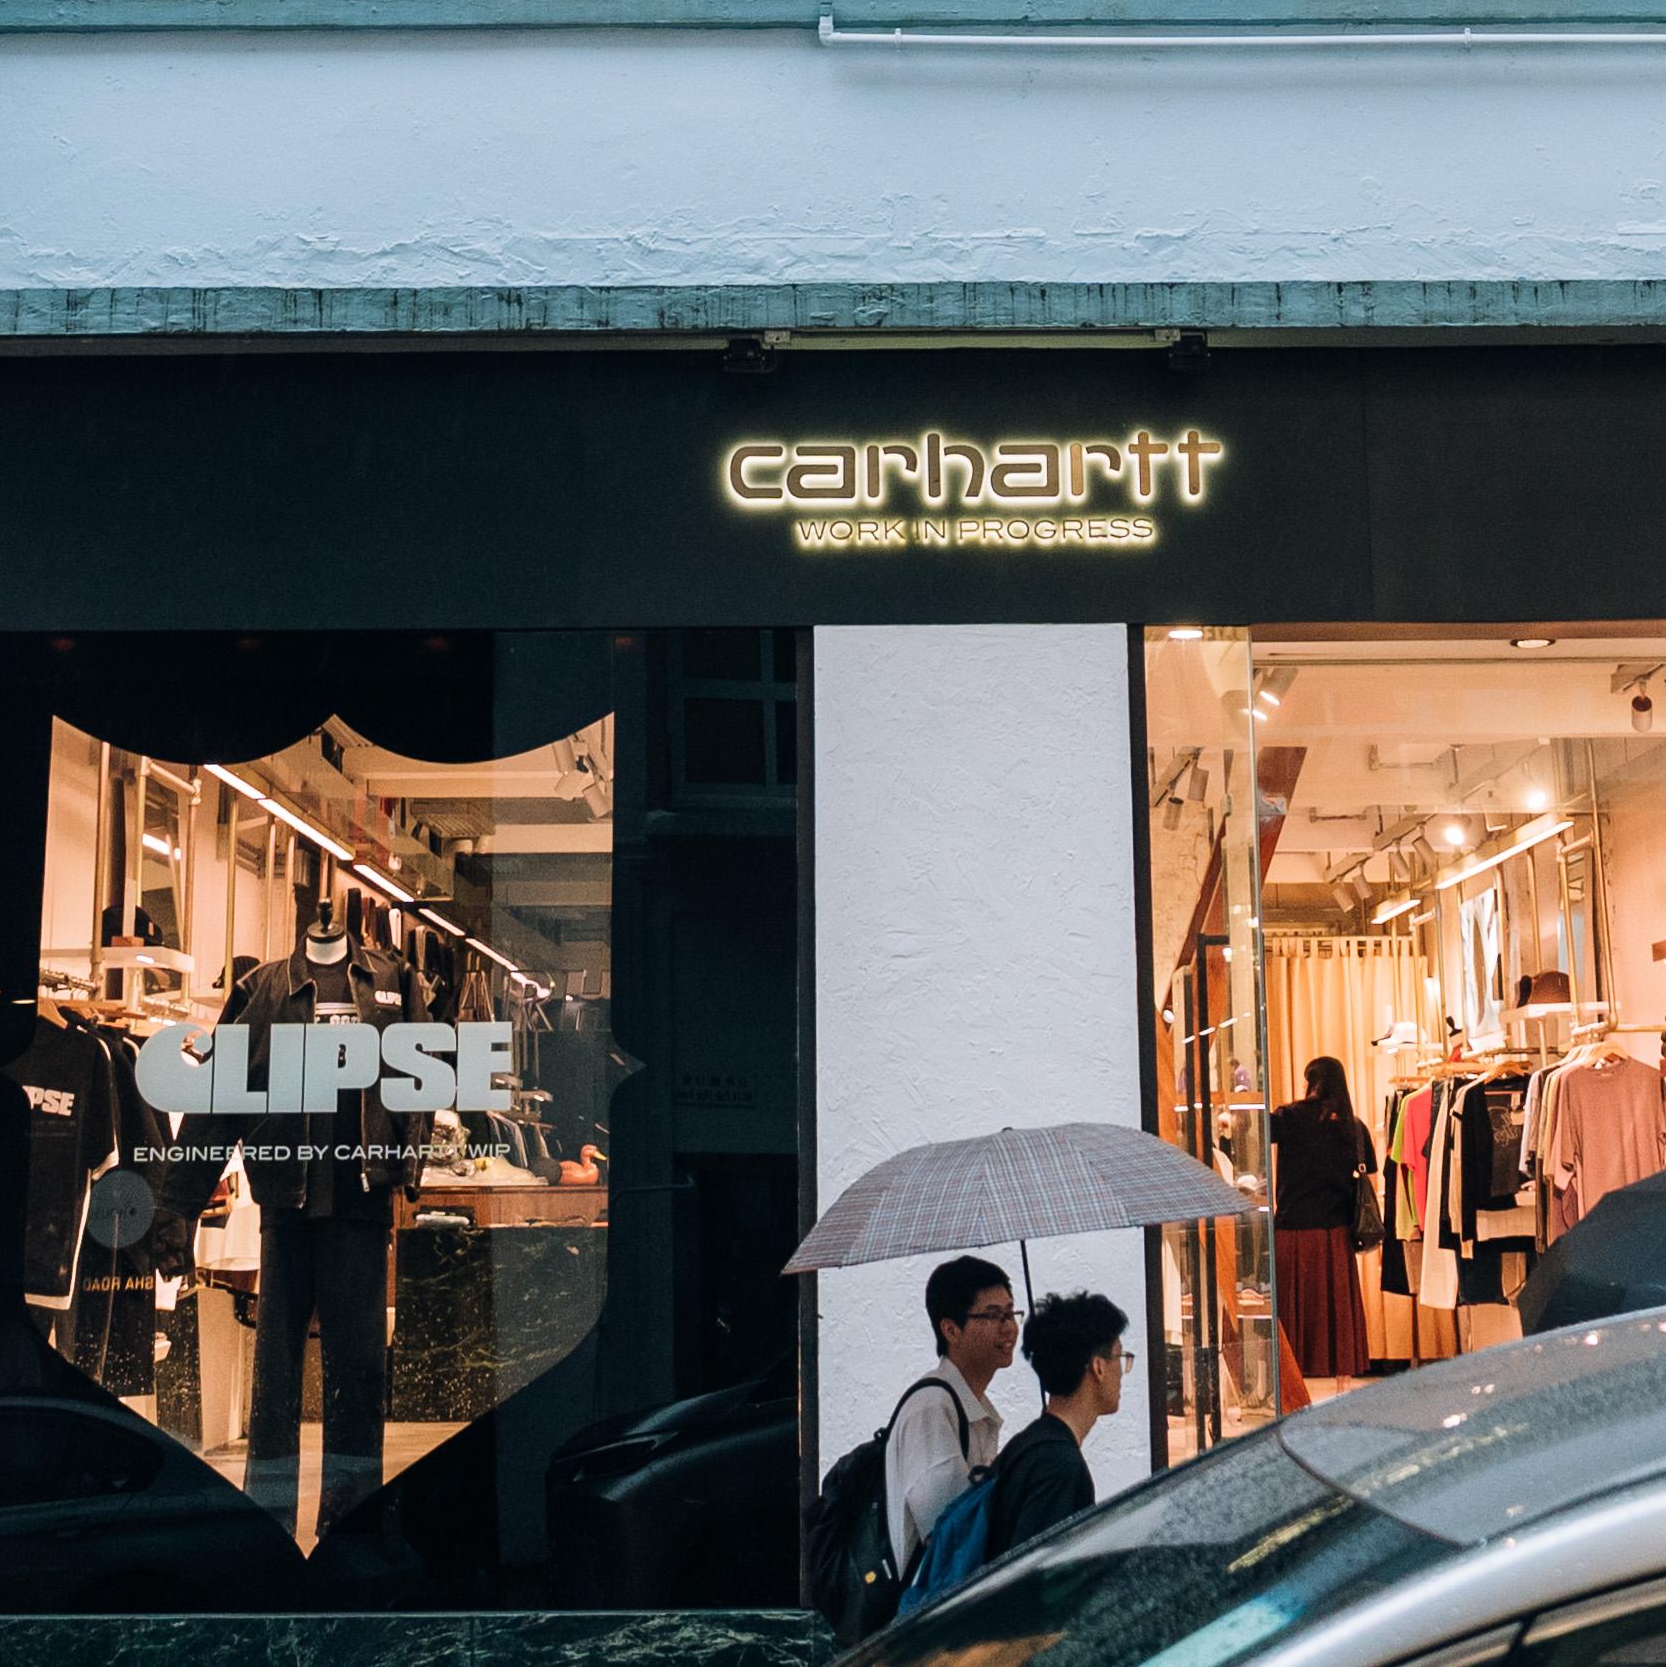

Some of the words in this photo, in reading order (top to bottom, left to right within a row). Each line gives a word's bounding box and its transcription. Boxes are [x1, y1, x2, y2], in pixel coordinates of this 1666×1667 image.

[729, 430, 1223, 501] carhartt
[797, 519, 904, 543] WORK
[914, 518, 947, 542] IN
[958, 517, 1155, 542] PROGRESS
[21, 1085, 75, 1117] PSE
[133, 1145, 290, 1162] ENGINEERED
[296, 1145, 329, 1161] BY
